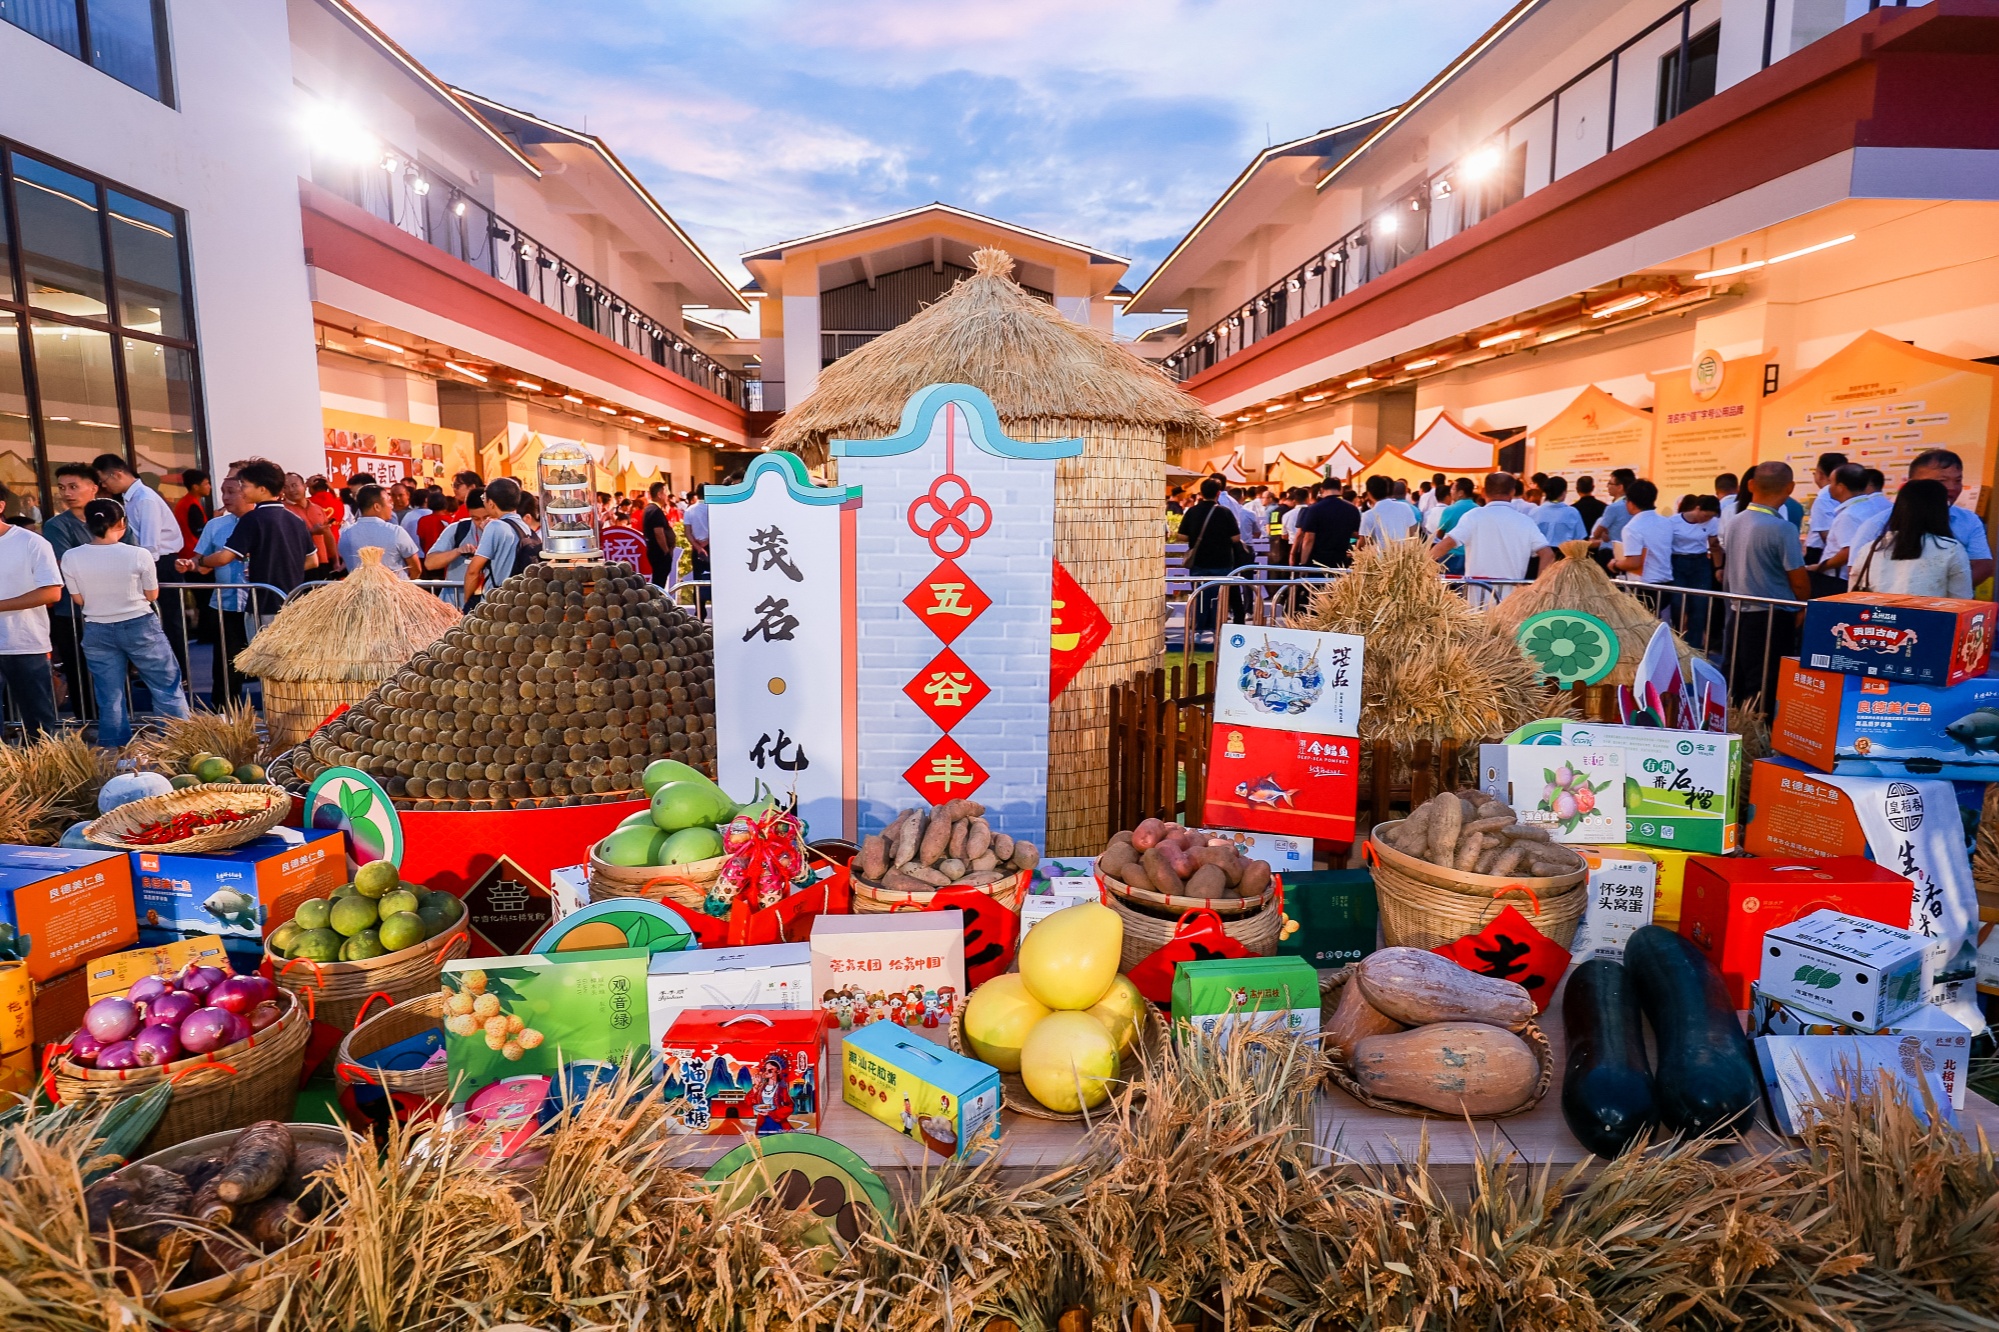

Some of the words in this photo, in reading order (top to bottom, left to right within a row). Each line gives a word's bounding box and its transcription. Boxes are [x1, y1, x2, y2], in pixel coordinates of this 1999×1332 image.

[1857, 701, 1931, 715] 良德美仁鱼
[1307, 740, 1350, 758] 金鲳鱼
[1324, 757, 1349, 765] POMFRET
[1644, 759, 1673, 774] 有机
[1781, 777, 1839, 801] 良德美仁鱼
[281, 849, 326, 872] 良德美仁鱼
[49, 873, 105, 899] 良德美仁鱼
[1599, 882, 1644, 899] 怀乡鸡
[1598, 897, 1643, 913] 头窝蛋
[612, 978, 630, 1027] 观音绿
